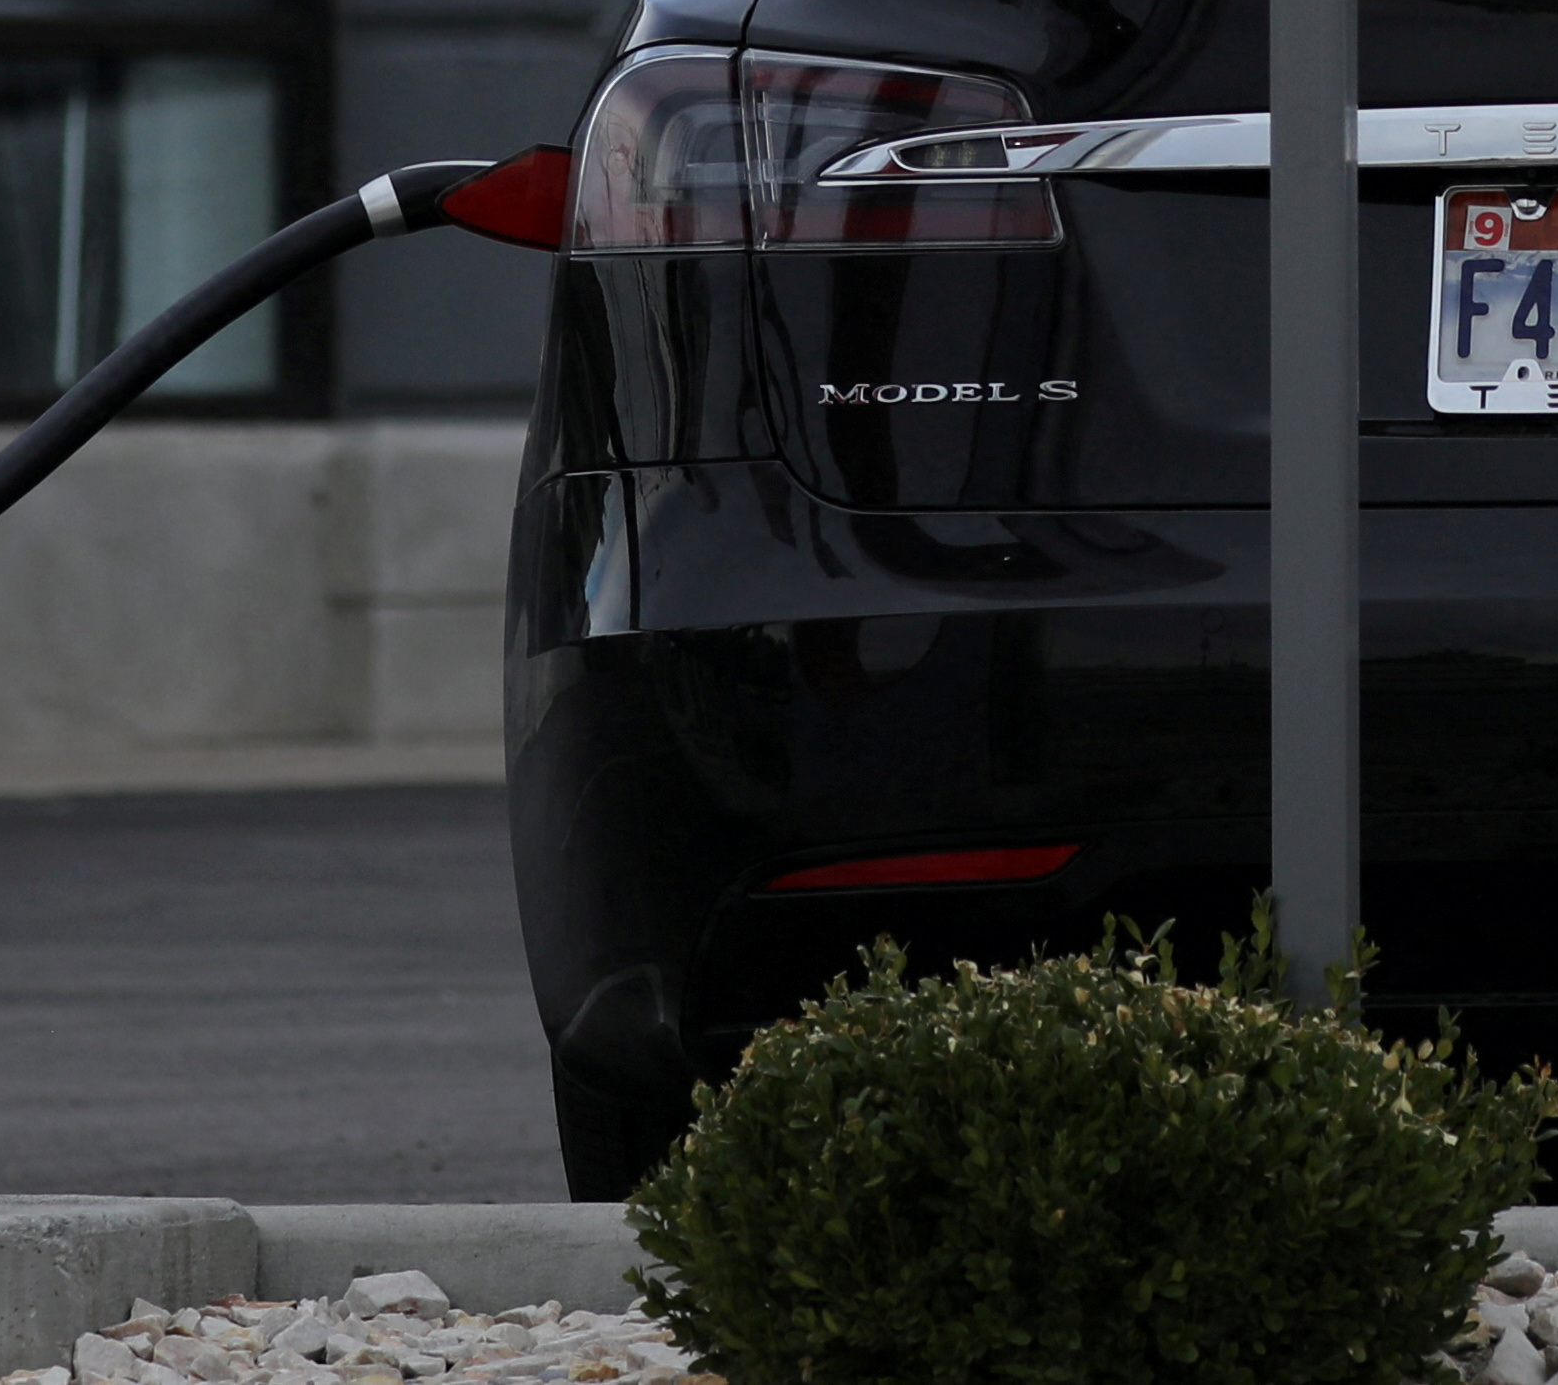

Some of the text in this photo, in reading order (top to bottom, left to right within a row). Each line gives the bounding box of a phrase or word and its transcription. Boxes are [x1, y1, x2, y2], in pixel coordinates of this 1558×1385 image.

[1473, 210, 1505, 248] 9
[817, 379, 1079, 405] MODEL S
